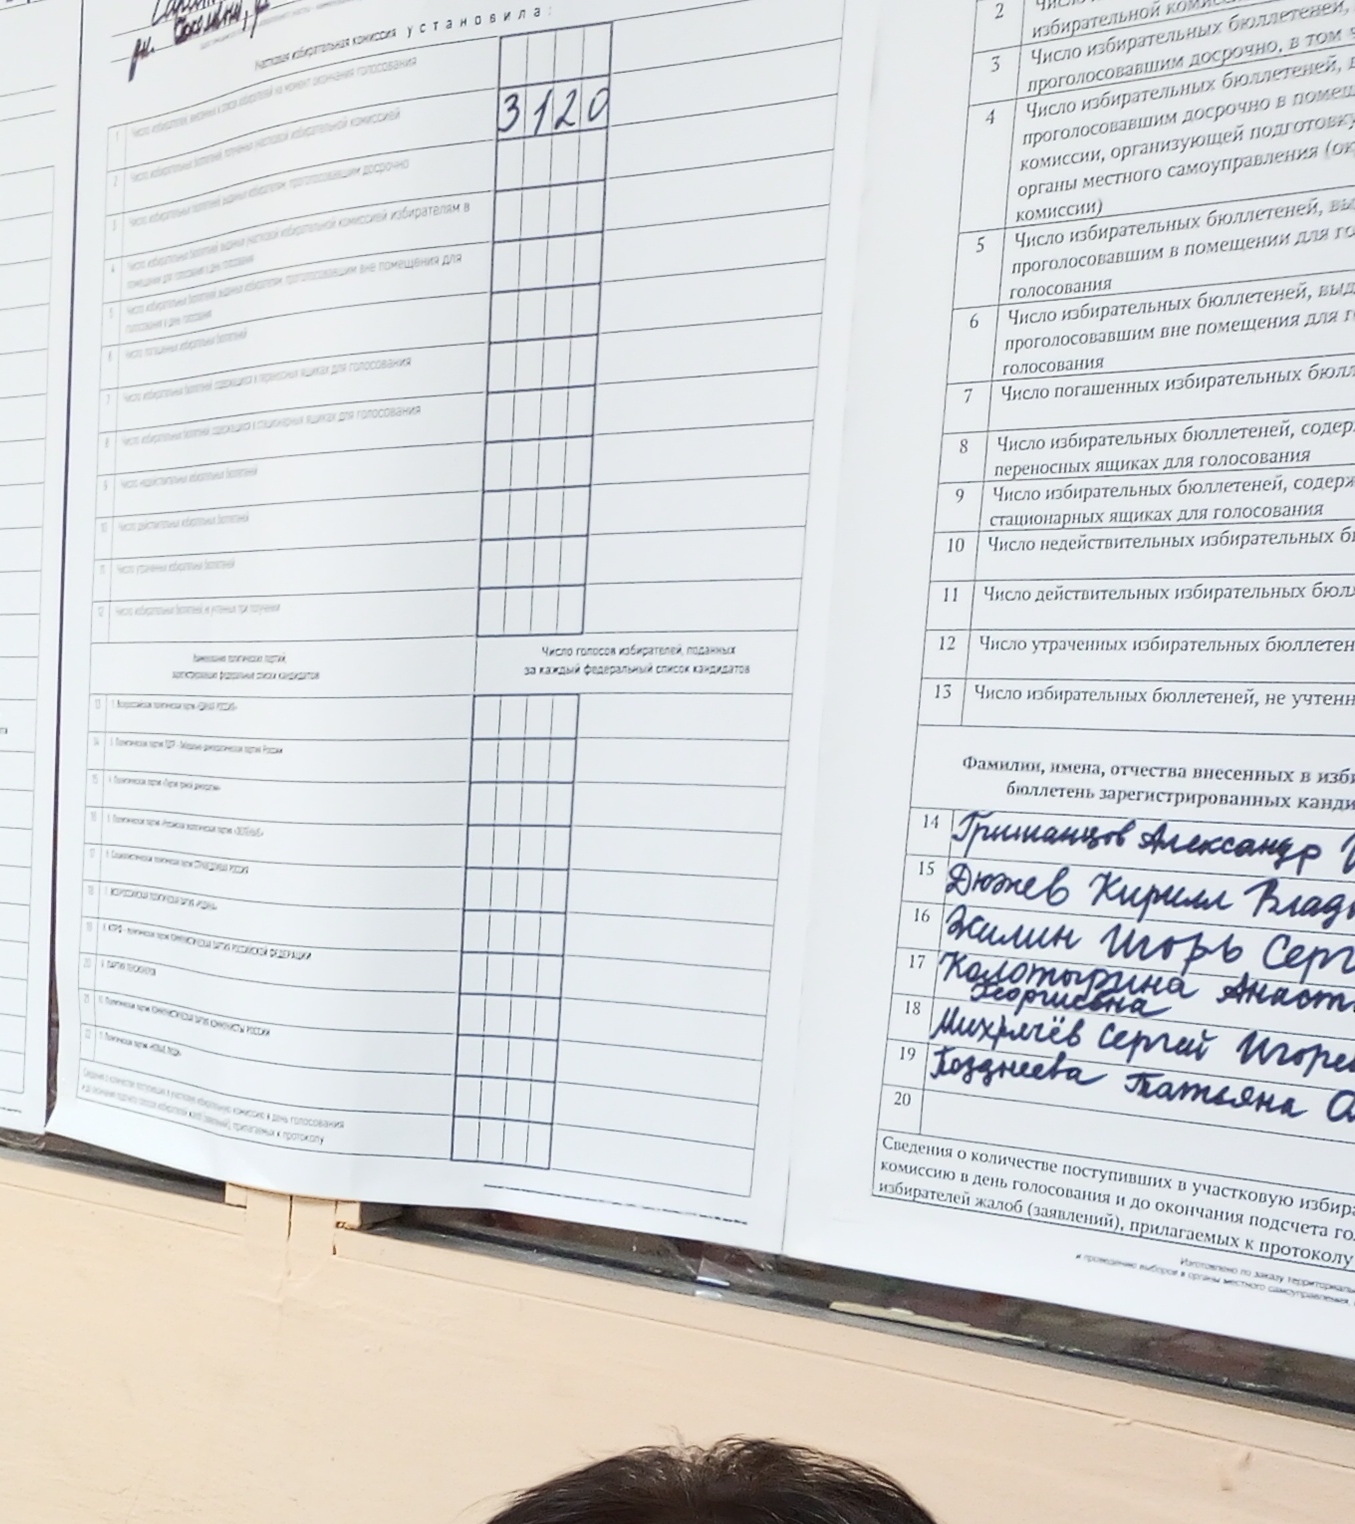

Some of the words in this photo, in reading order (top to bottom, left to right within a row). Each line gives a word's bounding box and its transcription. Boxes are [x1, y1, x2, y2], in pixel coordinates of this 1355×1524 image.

[991, 56, 1000, 72] 3
[1027, 56, 1184, 98] проголосовавшим
[1188, 41, 1282, 71] досрочно,
[1289, 37, 1299, 50] в
[1305, 29, 1342, 46] том
[498, 86, 610, 134] 3120
[985, 109, 995, 125] 4
[1023, 112, 1177, 148] проголосовавшим
[1182, 98, 1270, 124] досрочно
[1276, 96, 1286, 109] в
[1020, 149, 1105, 171] комиссии,
[1111, 124, 1244, 162] организующей
[1018, 178, 1077, 200] органы
[1082, 168, 1162, 188] местного
[1167, 146, 1318, 178] самоуправления
[1016, 199, 1103, 222] комиссии)
[1015, 232, 1064, 248] Число
[1069, 216, 1201, 242] избирательных
[1206, 197, 1323, 227] бюллетеней,
[976, 236, 985, 253] 5
[1012, 247, 1164, 277] проголосовавшим
[1169, 246, 1179, 258] в
[1184, 233, 1291, 256] помещении
[1295, 228, 1329, 246] для
[1009, 279, 1112, 299] голосования
[964, 388, 973, 403] 7
[1002, 380, 1049, 401] Число
[1054, 380, 1159, 398] погашенных
[1165, 369, 1302, 392] избирательных
[998, 436, 1045, 452] Число
[1050, 431, 1177, 451] избирательных
[1183, 419, 1294, 442] бюллетеней,
[959, 439, 968, 454] 8
[994, 461, 1090, 481] переносных
[1095, 458, 1159, 476] ящиках
[1162, 456, 1194, 474] для
[1199, 450, 1311, 467] голосования
[956, 488, 964, 503] 9
[993, 486, 1041, 502] Число
[1045, 483, 1172, 503] избирательных
[1177, 474, 1287, 495] бюллетеней,
[990, 512, 1105, 530] стационарных
[1109, 510, 1173, 527] ящиках
[1176, 508, 1208, 525] для
[1213, 504, 1324, 519] голосования
[948, 538, 965, 553] 10
[988, 536, 1035, 551] Число
[1040, 534, 1195, 552] недействительных
[1200, 530, 1335, 549] избирательных
[944, 587, 957, 602] 11
[984, 586, 1031, 601] Число
[1035, 585, 1170, 602] действительных
[1175, 583, 1306, 603] избирательных
[939, 636, 955, 650] 12
[980, 635, 1027, 651] Число
[1032, 640, 1127, 654] утраченных
[1133, 635, 1260, 655] избирательных
[935, 684, 951, 699] 13
[975, 684, 1022, 700] Число
[1027, 685, 1147, 704] избирательных
[1152, 687, 1259, 708] бюллетеней,
[1265, 693, 1286, 705] не
[963, 756, 1045, 775] Фамилии,
[1050, 762, 1105, 778] имена,
[1110, 765, 1186, 778] отчества
[1192, 768, 1294, 782] внесенных
[1299, 772, 1311, 783] в
[1007, 780, 1095, 799] бюллетень
[1099, 789, 1291, 808] зарегистрированных
[924, 814, 939, 829] 14
[919, 861, 935, 876] 15
[914, 908, 930, 923] 16
[910, 954, 925, 969] 17
[906, 1000, 921, 1015] 18
[900, 1046, 916, 1061] 19
[894, 1091, 911, 1106] 20
[883, 1136, 953, 1158] Сведения
[957, 1150, 967, 1160] о
[971, 1151, 1057, 1173] количестве
[1062, 1164, 1172, 1189] поступивших
[1177, 1180, 1186, 1191] в
[1192, 1182, 1294, 1208] участковую
[881, 1161, 956, 1181] комиссию
[960, 1172, 968, 1183] в
[972, 1174, 1008, 1188] день
[1012, 1180, 1110, 1204] голосования
[1116, 1195, 1125, 1206] и
[1129, 1198, 1150, 1211] до
[1155, 1201, 1244, 1224] окончания
[1249, 1215, 1328, 1237] подсчета
[879, 1182, 970, 1209] избирателей
[975, 1197, 1023, 1217] жалоб
[1027, 1202, 1124, 1236] (заявлений),
[1130, 1221, 1240, 1248] прилагаемых
[1245, 1239, 1254, 1250] к
[1259, 1241, 1353, 1271] протоколу
